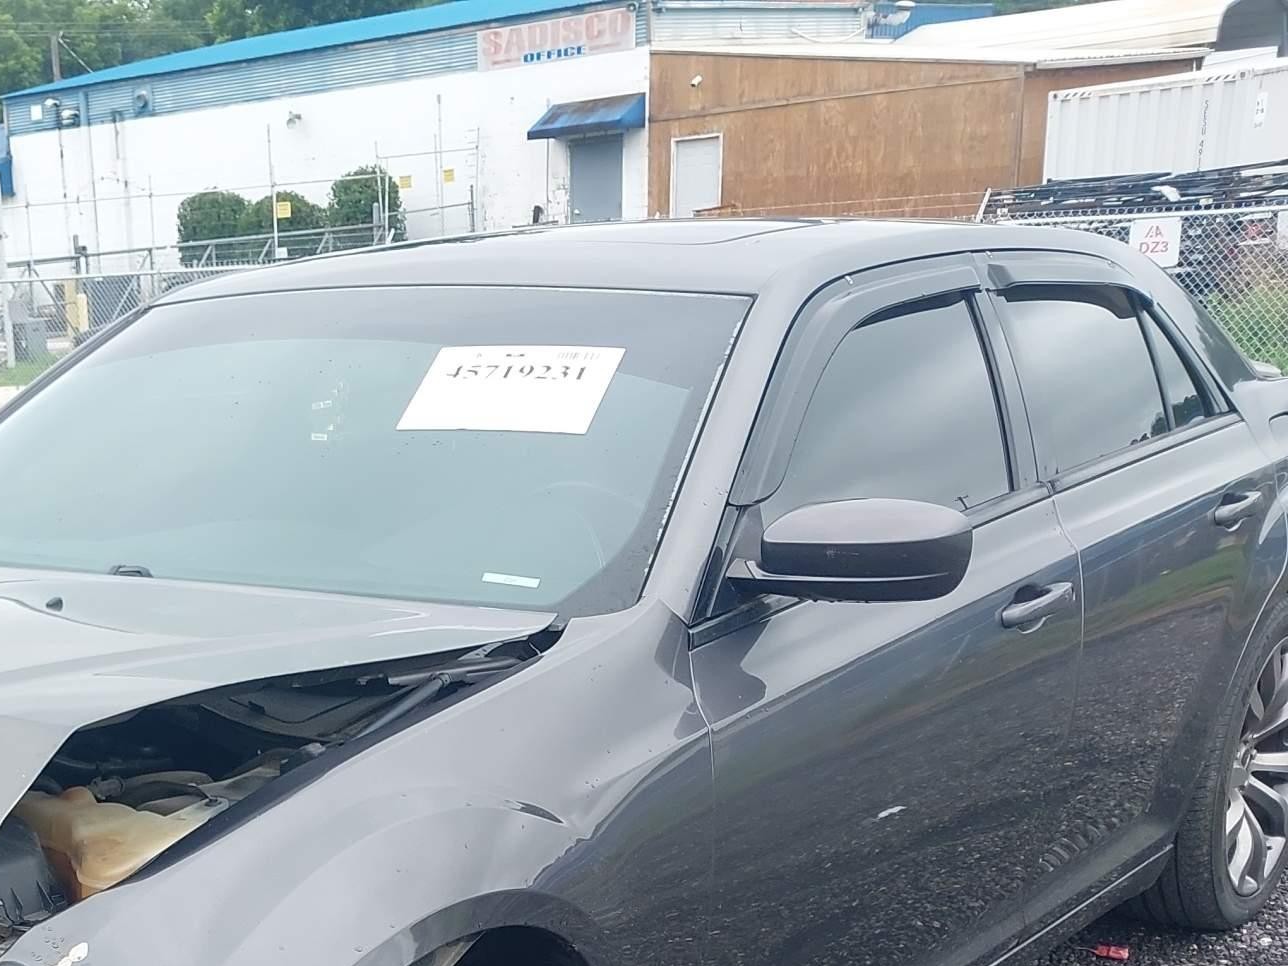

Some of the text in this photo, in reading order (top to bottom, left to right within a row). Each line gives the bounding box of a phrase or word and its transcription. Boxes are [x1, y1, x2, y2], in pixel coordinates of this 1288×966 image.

[482, 11, 632, 57] SADISCO
[523, 45, 586, 64] OFFICE
[1139, 240, 1169, 255] DZ3
[446, 364, 587, 381] 45719231
